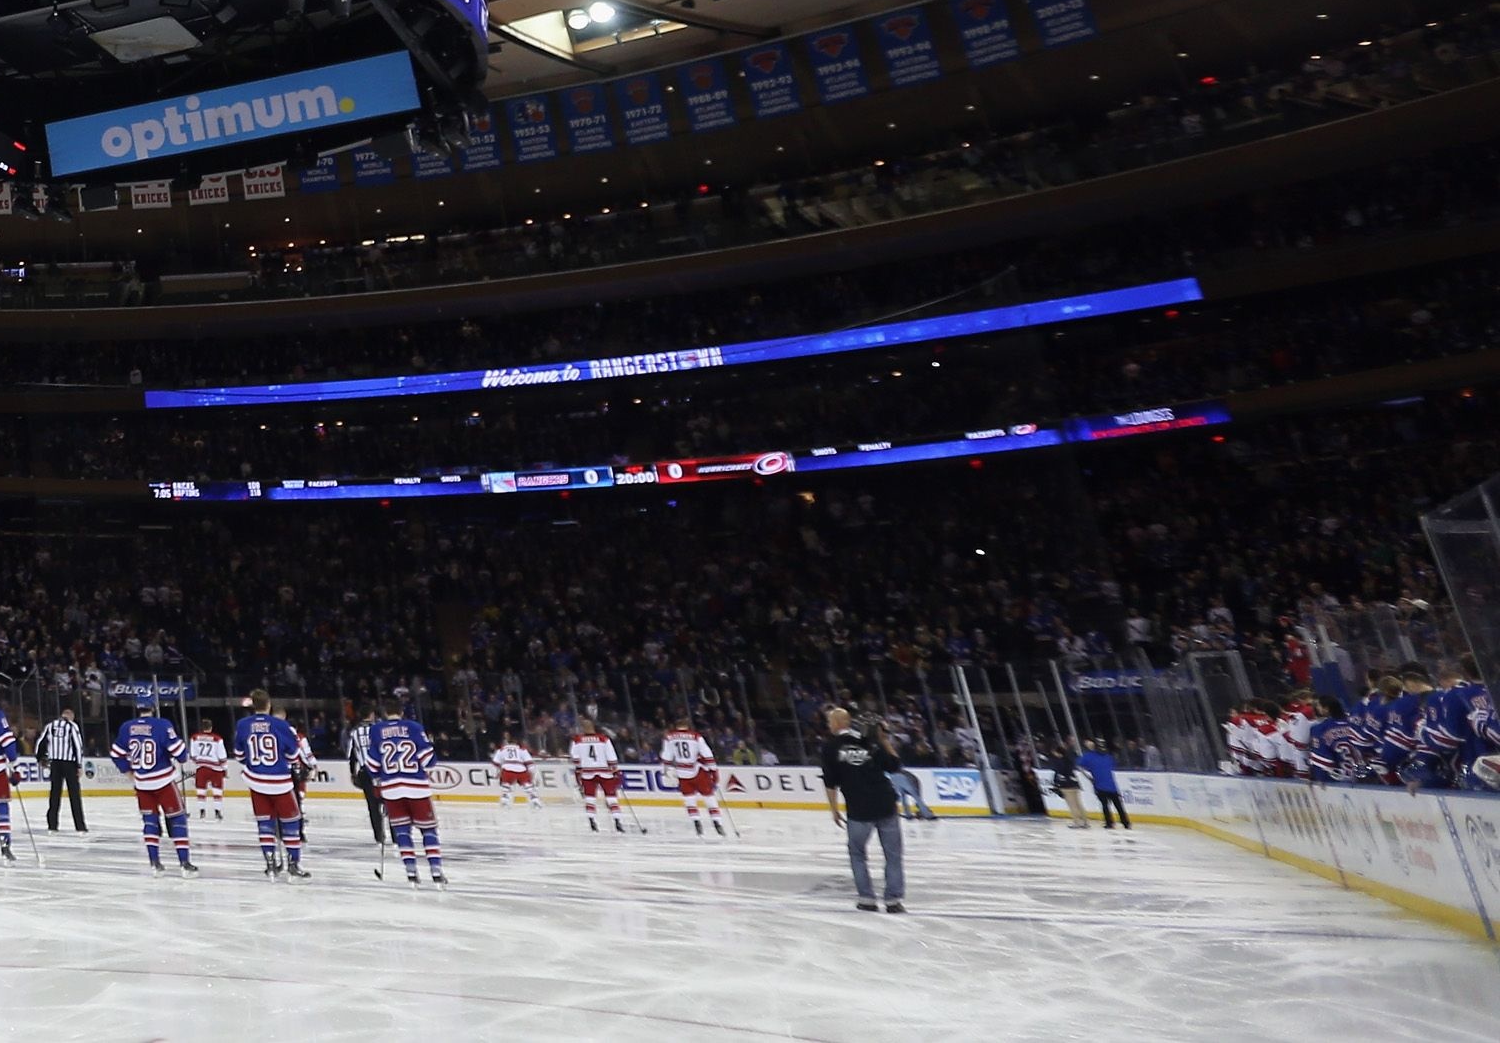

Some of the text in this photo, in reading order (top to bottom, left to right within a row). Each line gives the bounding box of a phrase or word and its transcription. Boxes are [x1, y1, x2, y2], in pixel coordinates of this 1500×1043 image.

[569, 114, 607, 129] 1970-71
[191, 187, 226, 200] KNICKS
[246, 181, 282, 195] KNICKS
[134, 193, 169, 204] KNICKS
[482, 346, 724, 388] Welcome to RANGERSTWN
[584, 468, 599, 485] 0
[615, 471, 655, 485] 20:00
[667, 463, 683, 479] 0
[394, 476, 422, 485] PENALTY
[517, 474, 569, 487] RANGERS
[148, 685, 188, 695] LGHT
[128, 738, 157, 770] 28
[247, 733, 278, 767] 19
[380, 740, 419, 774] 22
[588, 744, 597, 762] 4
[674, 741, 691, 759] 18
[18, 762, 50, 783] GEIC
[429, 772, 454, 784] KIA
[469, 769, 558, 788] CHE
[621, 769, 679, 792] EIC
[757, 774, 824, 792] DEL
[934, 775, 973, 798] SAP
